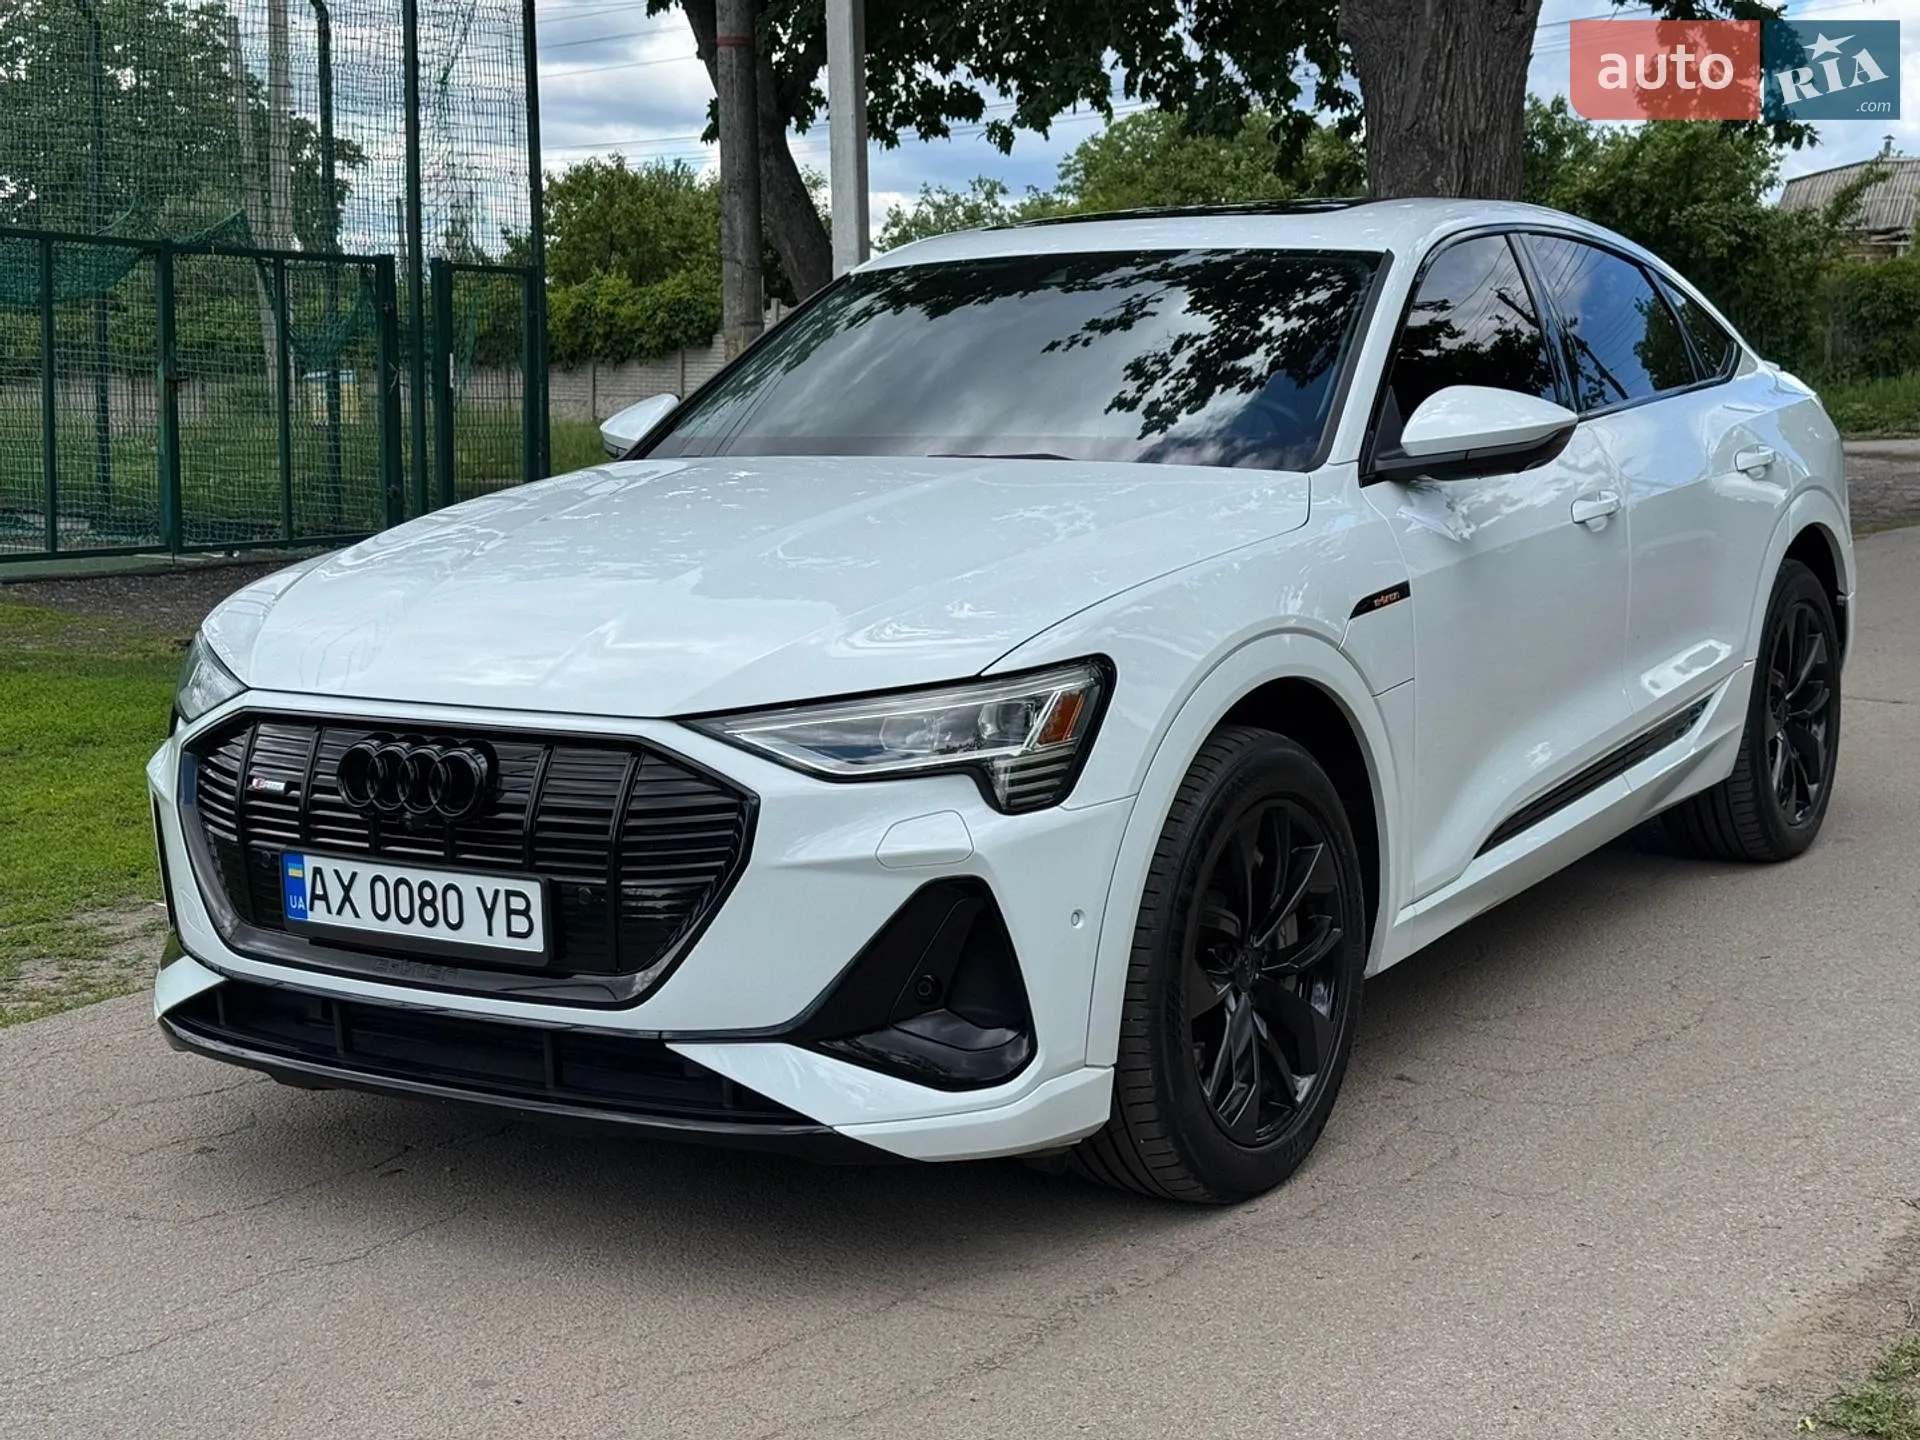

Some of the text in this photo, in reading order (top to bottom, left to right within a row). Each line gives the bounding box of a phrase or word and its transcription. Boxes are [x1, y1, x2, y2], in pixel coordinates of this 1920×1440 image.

[289, 895, 306, 910] UA
[308, 866, 535, 939] AX 0080 YB
